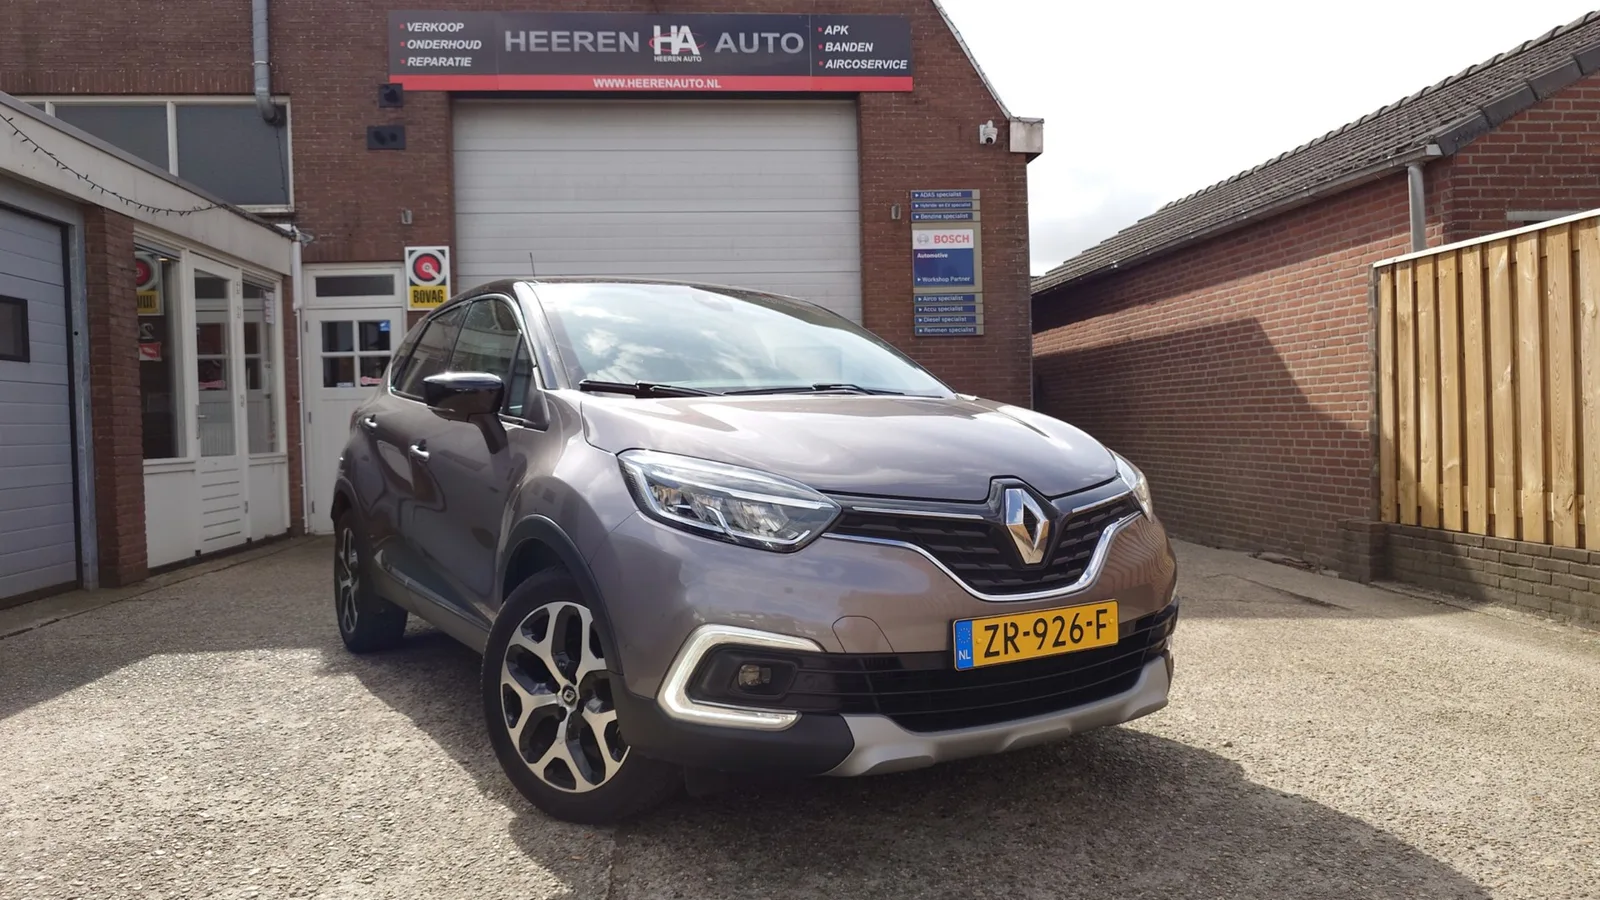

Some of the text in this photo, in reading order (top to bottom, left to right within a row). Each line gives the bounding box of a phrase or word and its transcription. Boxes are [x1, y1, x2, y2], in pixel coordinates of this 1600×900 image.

[407, 22, 464, 33] VERKOOP
[825, 25, 849, 36] APK
[407, 40, 482, 50] ONDERHOUD
[505, 25, 805, 55] HEEREN HA AUTO
[825, 42, 874, 53] BANDEN
[407, 57, 472, 67] REPARATIE
[825, 59, 908, 70] AIRCOSERVICE
[593, 78, 721, 89] WWW.HEERENAUTO.NL
[934, 234, 970, 244] BOSCH
[413, 290, 443, 303] BOVAG
[984, 608, 1108, 658] ZR-926-F
[958, 650, 971, 660] NL
